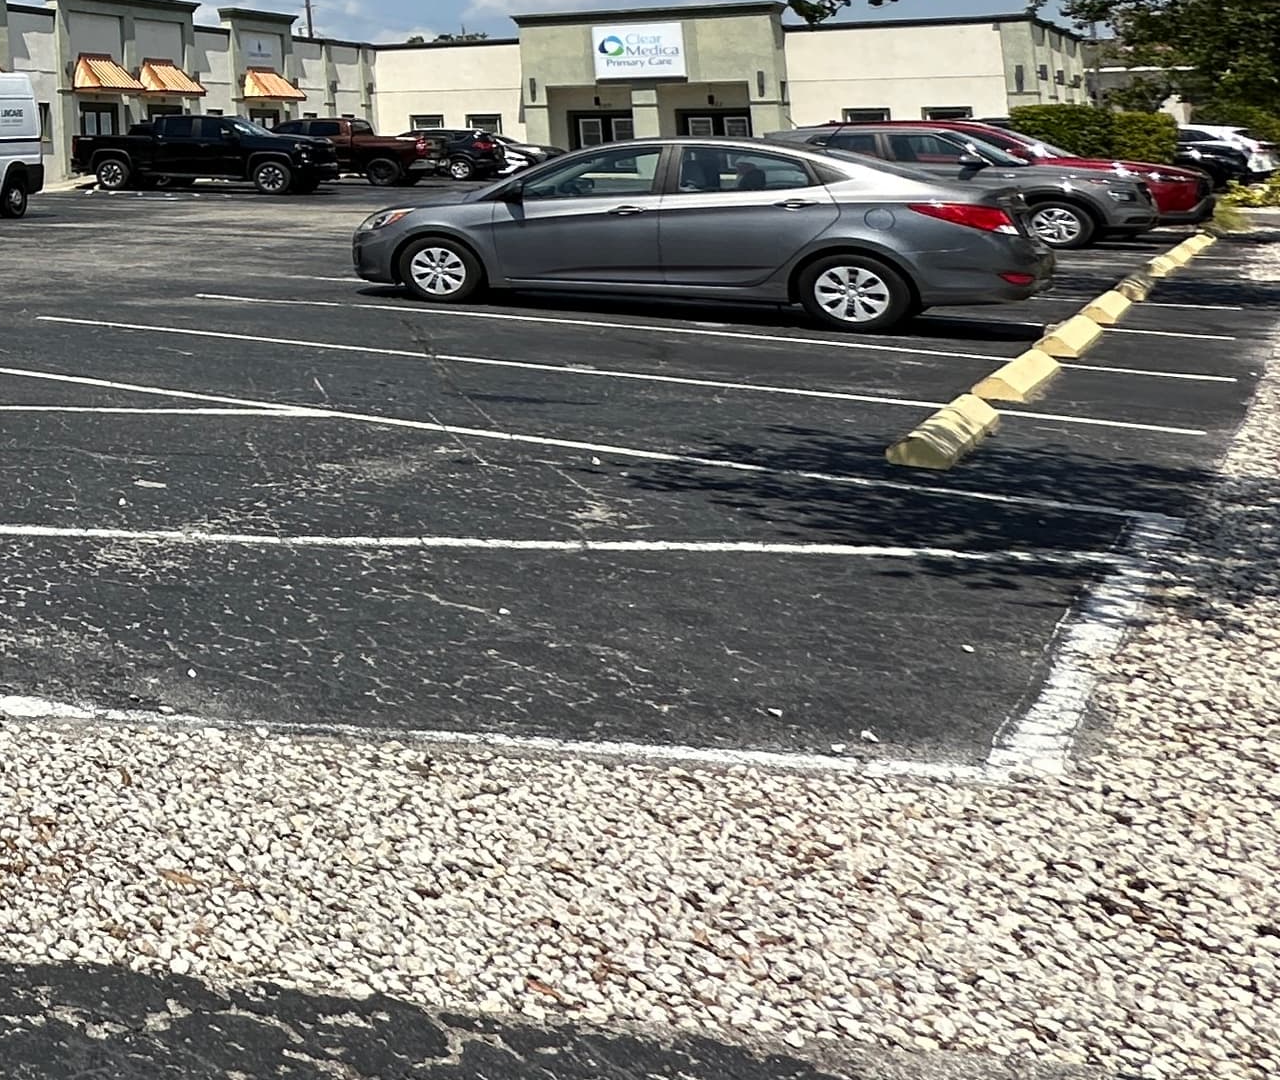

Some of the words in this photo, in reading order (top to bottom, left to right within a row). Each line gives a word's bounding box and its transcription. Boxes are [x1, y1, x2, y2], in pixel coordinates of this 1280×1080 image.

[625, 33, 662, 44] Clear
[626, 45, 680, 56] Medica
[606, 58, 646, 67] Primary
[648, 57, 673, 66] Care
